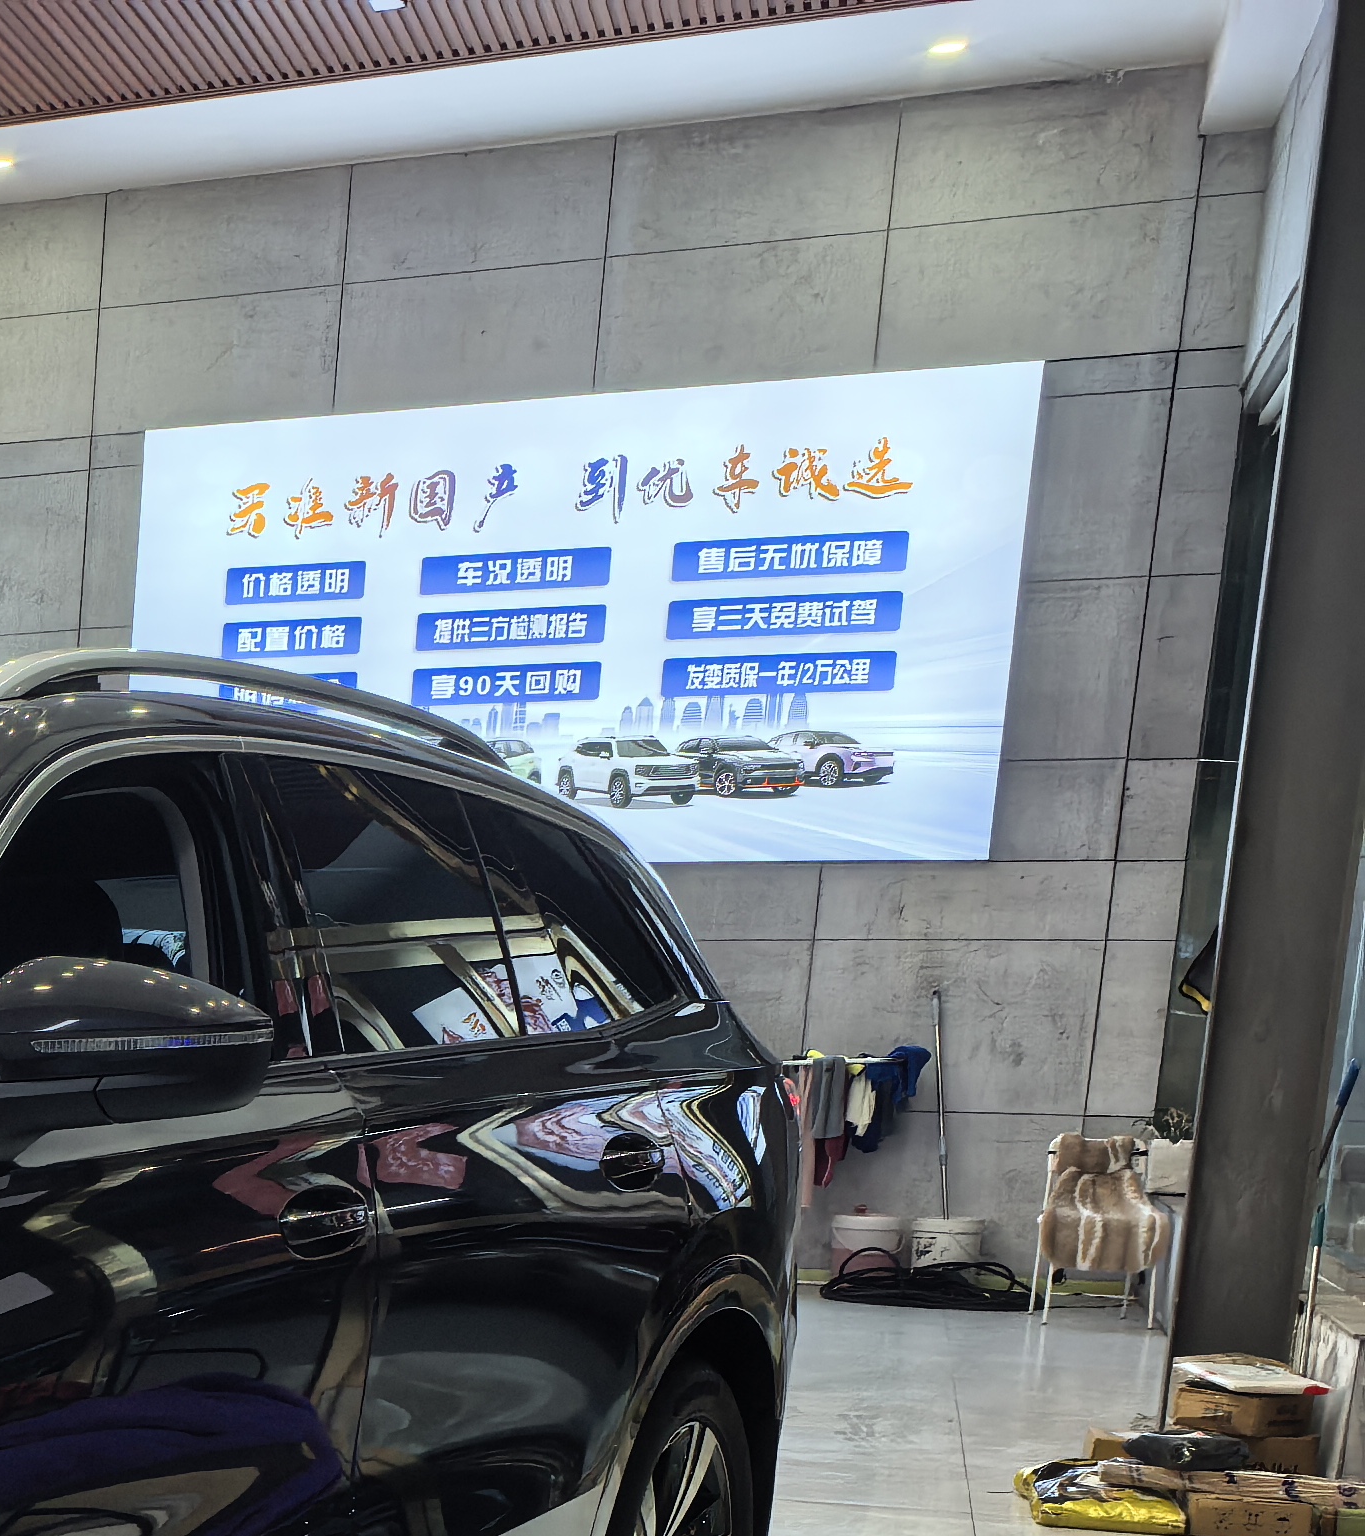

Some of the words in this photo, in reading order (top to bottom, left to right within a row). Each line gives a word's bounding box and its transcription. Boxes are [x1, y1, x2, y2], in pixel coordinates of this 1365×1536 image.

[456, 555, 574, 587] 车况透明
[697, 539, 883, 574] 售后无忧保障
[242, 568, 351, 599] 价格透明
[433, 611, 588, 645] 提供三方检测报告
[691, 598, 878, 632] 享三天免费试驾
[236, 624, 347, 653] 配置价格
[430, 668, 582, 700] 享90天回购
[685, 658, 871, 690] 发变质保一年/2万公里
